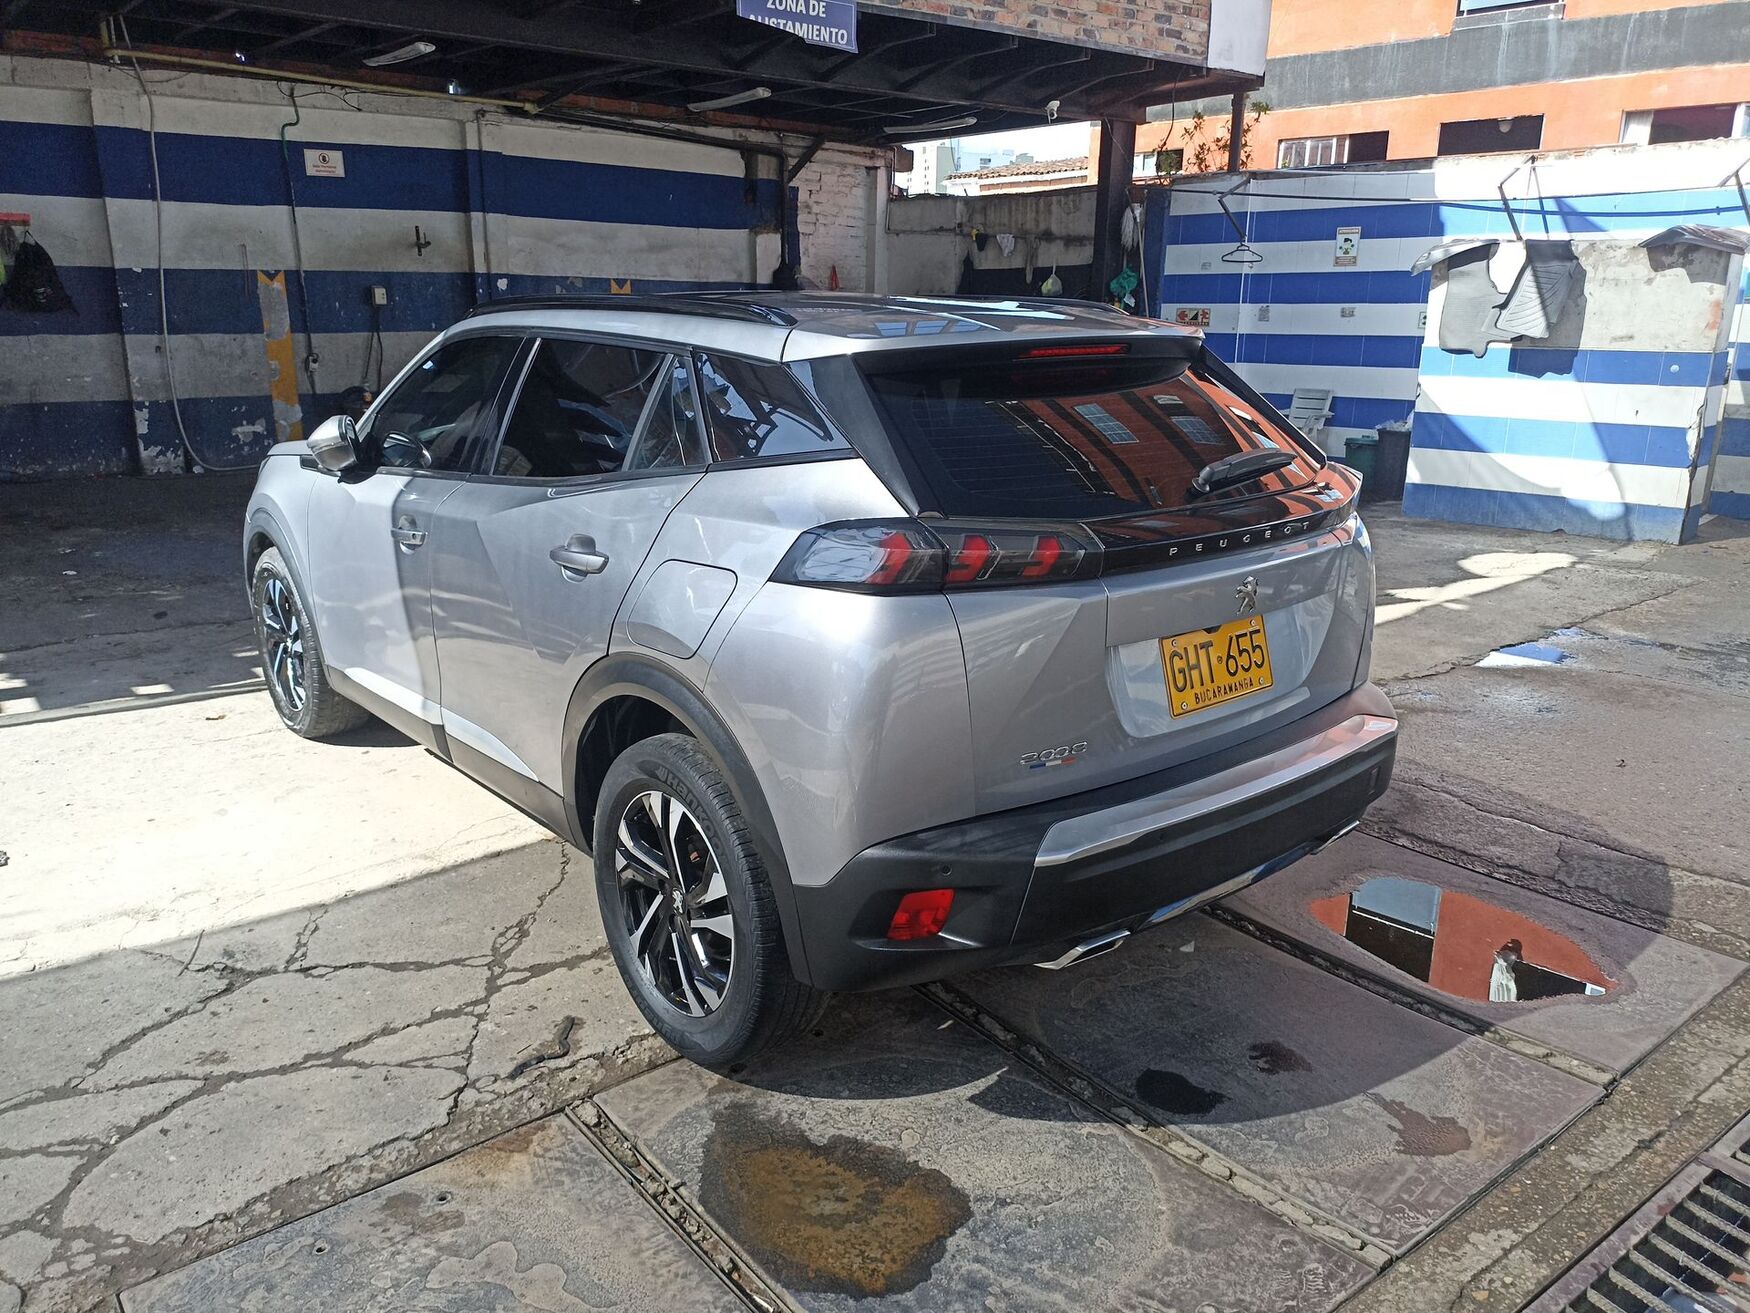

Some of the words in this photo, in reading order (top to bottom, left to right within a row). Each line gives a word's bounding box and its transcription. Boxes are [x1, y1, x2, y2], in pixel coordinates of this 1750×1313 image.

[766, 0, 806, 14] ZONA
[809, 0, 826, 17] DE
[1169, 522, 1309, 556] PEUGEOT
[1169, 640, 1215, 693] GHT
[1225, 629, 1265, 677] 655
[1194, 676, 1254, 704] BUCARAMANGA
[1020, 741, 1088, 764] 2008
